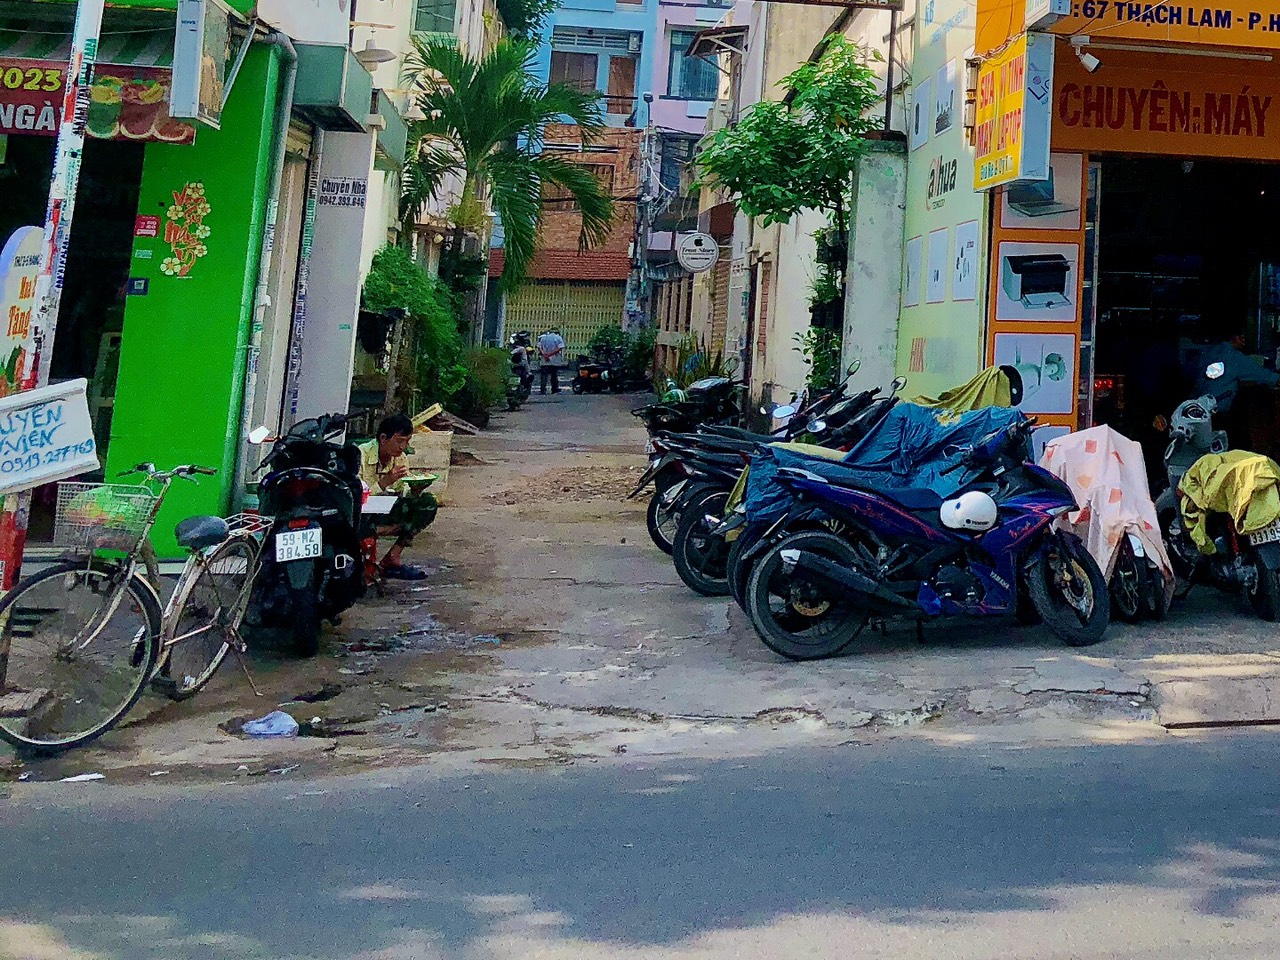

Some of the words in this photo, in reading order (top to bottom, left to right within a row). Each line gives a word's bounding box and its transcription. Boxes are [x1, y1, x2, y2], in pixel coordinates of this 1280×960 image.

[1114, 1, 1182, 26] THẠCH
[1188, 8, 1232, 28] LAM
[0, 67, 62, 92] 023
[0, 100, 64, 131] NGÀ
